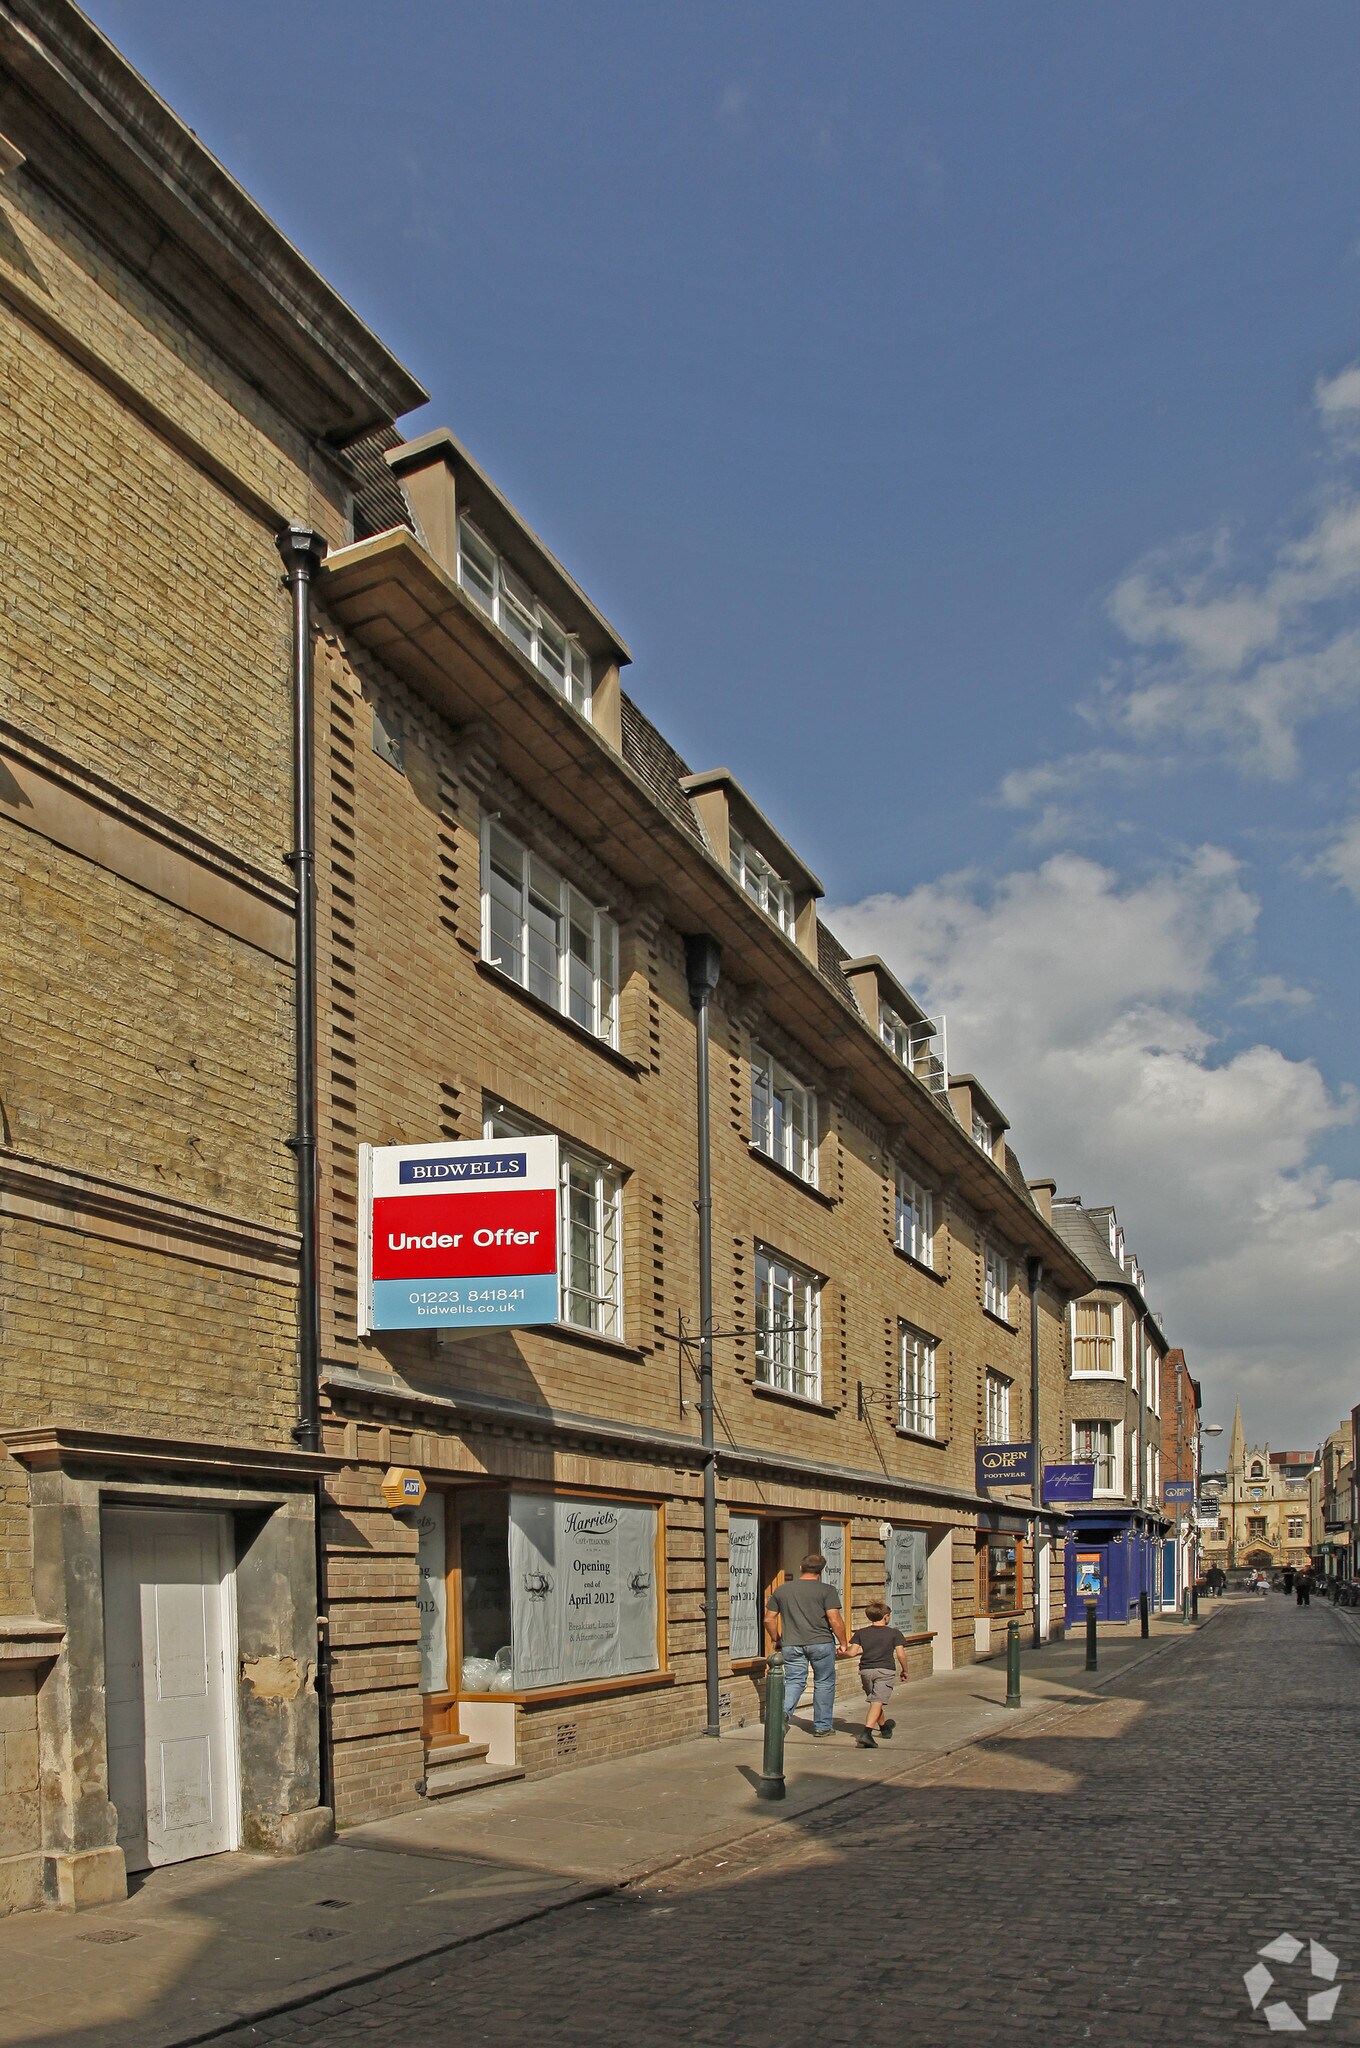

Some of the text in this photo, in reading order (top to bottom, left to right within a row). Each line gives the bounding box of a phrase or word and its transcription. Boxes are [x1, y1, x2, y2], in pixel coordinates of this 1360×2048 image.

[412, 1160, 520, 1179] BIDWELLS
[388, 1228, 540, 1251] Under Offer
[409, 1289, 526, 1304] 01223 841841
[417, 1303, 516, 1315] bidwells.co.uk
[404, 1483, 420, 1493] ADT
[564, 1511, 618, 1535] Harriets
[573, 1559, 611, 1576] Opening
[595, 1580, 601, 1588] of
[568, 1592, 615, 1609] April 2012
